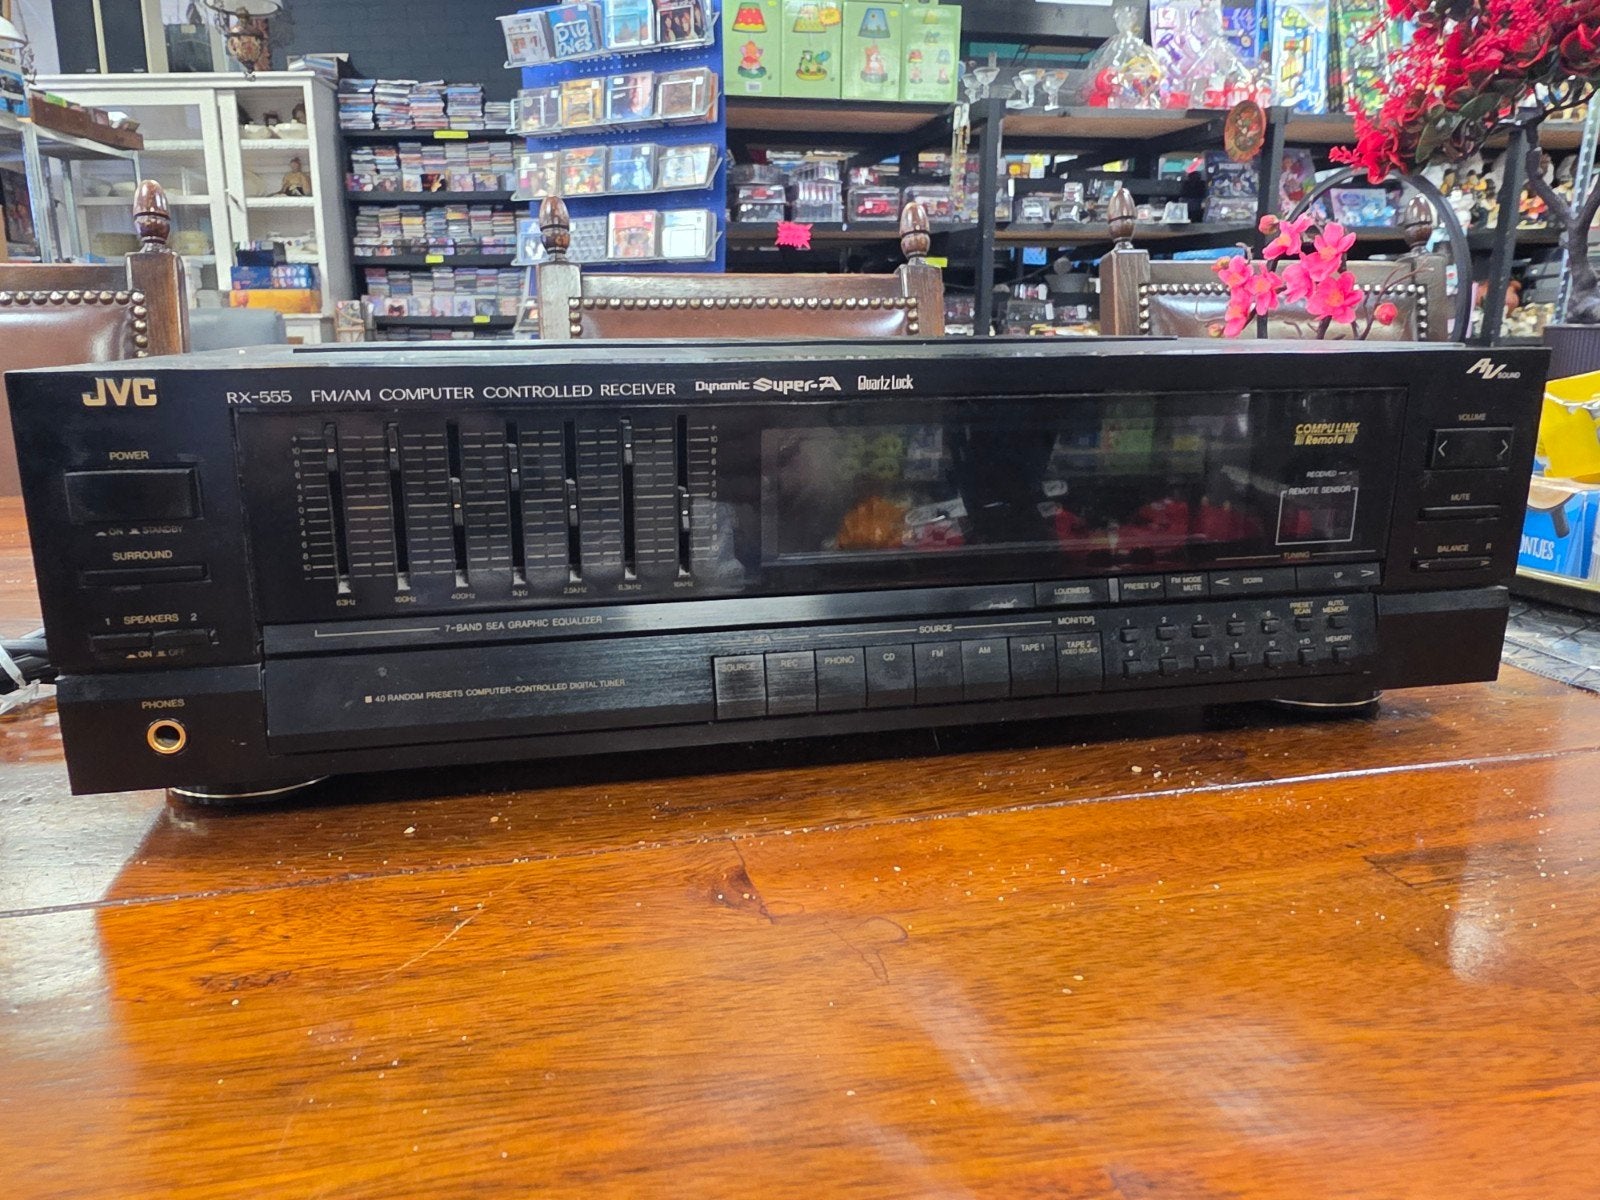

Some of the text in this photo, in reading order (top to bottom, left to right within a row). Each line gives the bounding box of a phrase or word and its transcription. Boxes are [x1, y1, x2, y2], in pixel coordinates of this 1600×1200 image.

[696, 376, 842, 394] Dynamic Super-A
[858, 374, 914, 391] Quartz Lock
[82, 377, 157, 406] JVC
[226, 383, 676, 404] RX-555 FM/AM COMPUTER CONTROLLED RECEIVER
[1458, 413, 1486, 422] VOLUME
[1305, 434, 1344, 445] Remote
[109, 450, 149, 460] POWER
[1288, 485, 1352, 495] REMOTE SENSOR
[1451, 493, 1470, 501] MUTE
[143, 524, 183, 534] STANDBY
[1437, 544, 1468, 553] BALANCE
[112, 550, 172, 561] SURROUND
[1054, 587, 1090, 595] LOUDNESS
[124, 614, 179, 625] SPEAKERS
[190, 613, 197, 622] 2
[445, 616, 603, 632] 7-BAND SEA GRAPHIC EQUALIZER
[1058, 616, 1095, 625] MONITOR
[919, 624, 952, 634] SOURCE
[1325, 634, 1352, 643] MEMORY
[138, 650, 152, 658] ON
[883, 653, 895, 661] CD
[781, 659, 798, 668] REC
[824, 655, 855, 665] PHONO
[721, 662, 756, 672] SOURCE
[375, 678, 625, 703] 40 RANDOM PRESETS COMPUTER-CONTROLLED DIGITAL TUNER
[142, 698, 185, 709] PHONES
